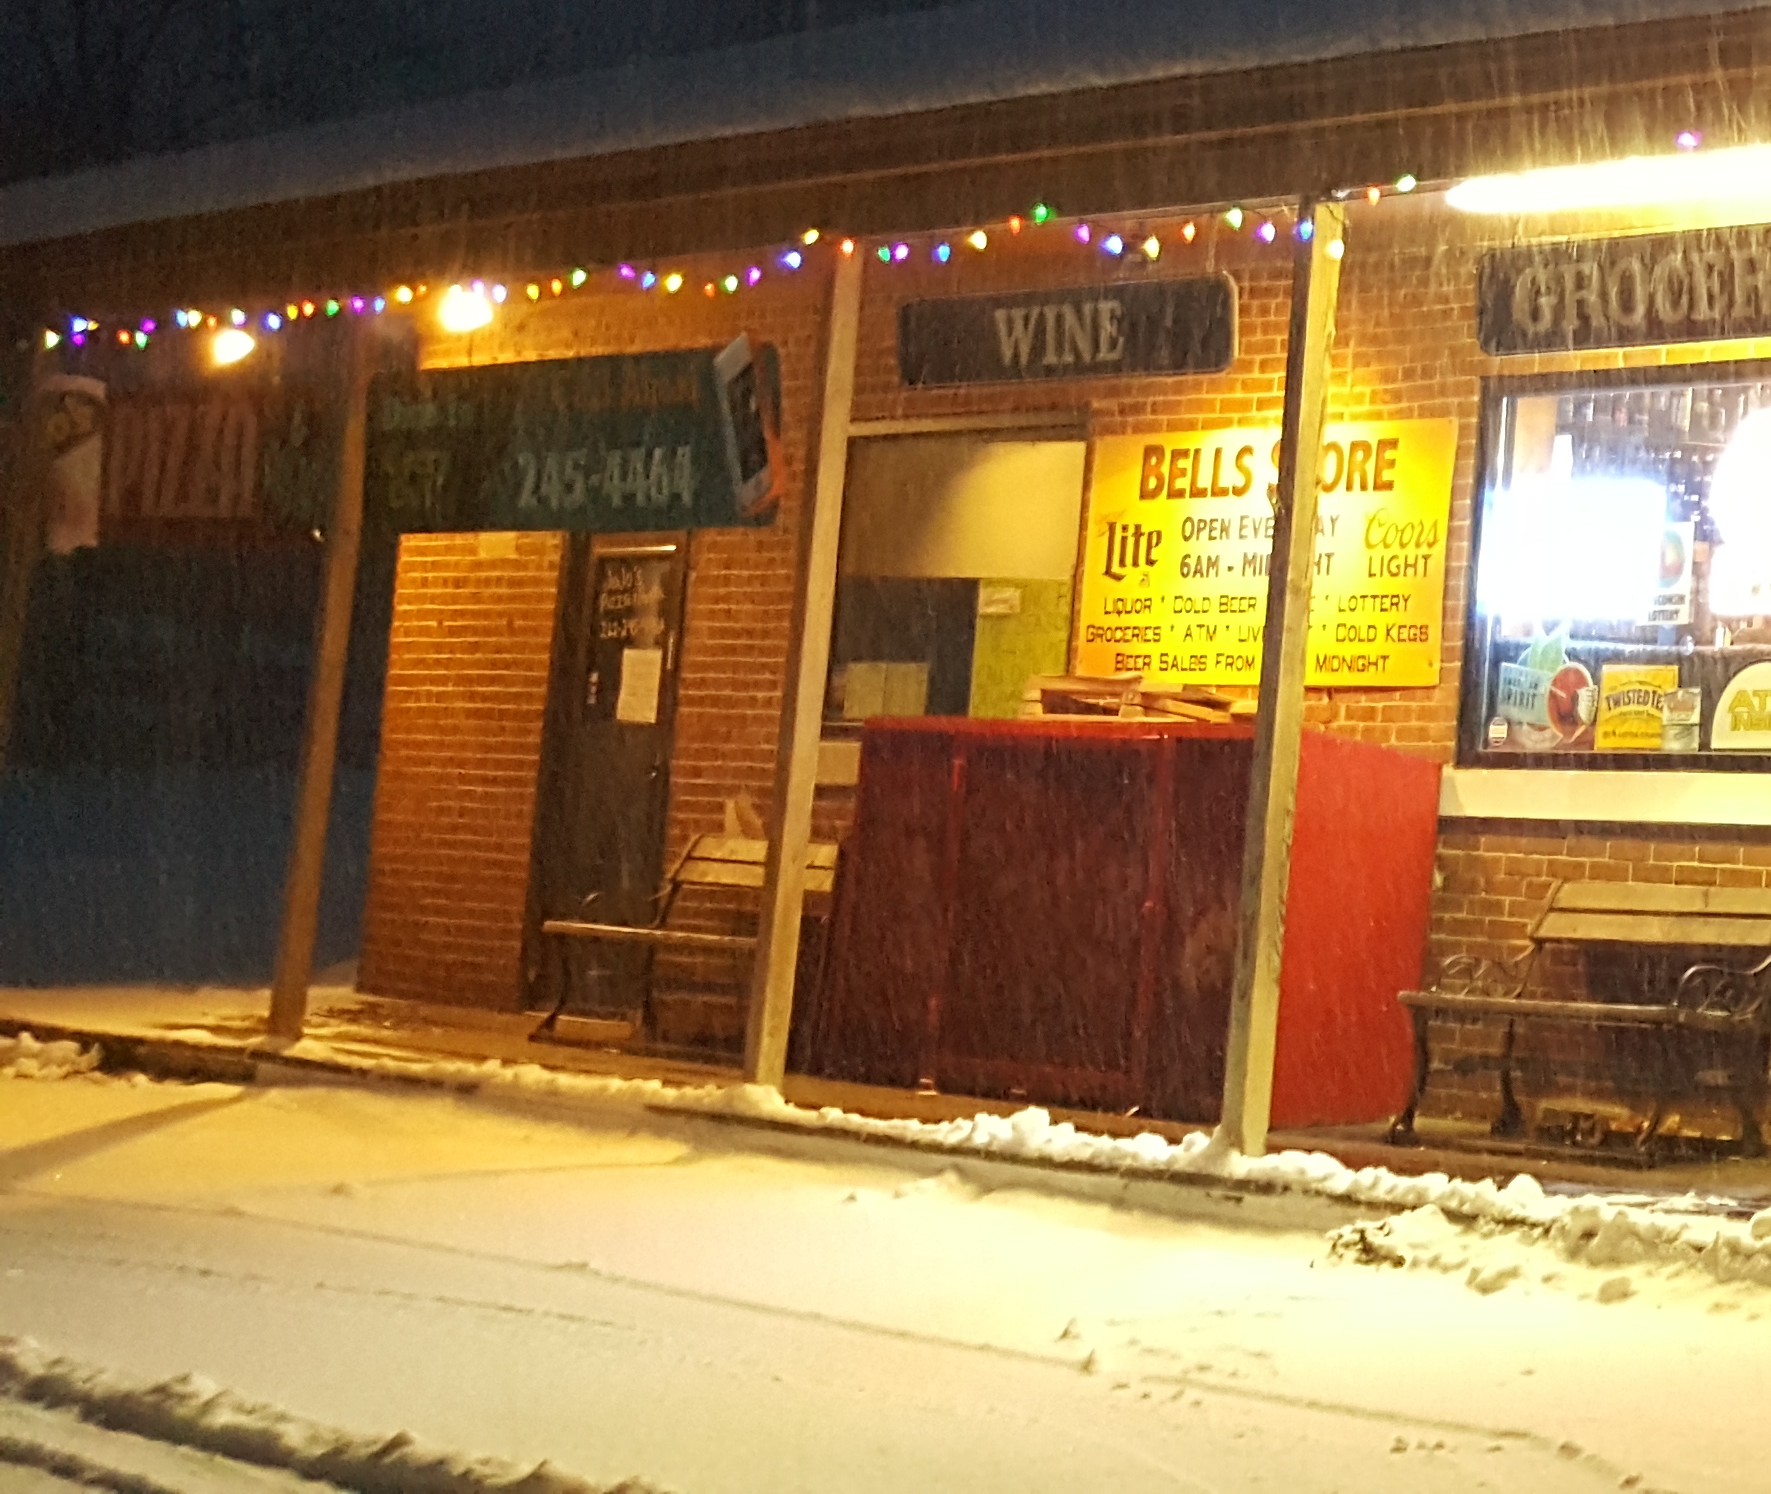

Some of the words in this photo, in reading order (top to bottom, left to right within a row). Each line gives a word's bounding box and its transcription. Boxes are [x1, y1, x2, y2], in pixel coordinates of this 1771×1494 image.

[995, 300, 1126, 367] WINE
[1139, 443, 1254, 501] BELLS
[1270, 438, 1399, 494] ORE
[1102, 521, 1163, 583] Lite
[1181, 516, 1232, 542] OPEN
[1365, 507, 1440, 550] Coors
[1180, 553, 1221, 579] 6AM
[1367, 554, 1432, 578] LIGHT
[1104, 597, 1152, 617] LIQUOR
[1172, 595, 1212, 614] COLD
[1219, 595, 1258, 613] BEER
[1338, 594, 1412, 613] LOTTERY
[1086, 624, 1161, 643] GROCERIES
[1183, 624, 1217, 643] ATM
[1335, 623, 1378, 643] COLD
[1385, 623, 1430, 643] KEGS
[1115, 653, 1152, 672] BEER
[1158, 653, 1208, 672] SALES
[1215, 653, 1257, 672] FROM
[1315, 653, 1391, 674] MIDNIGHT
